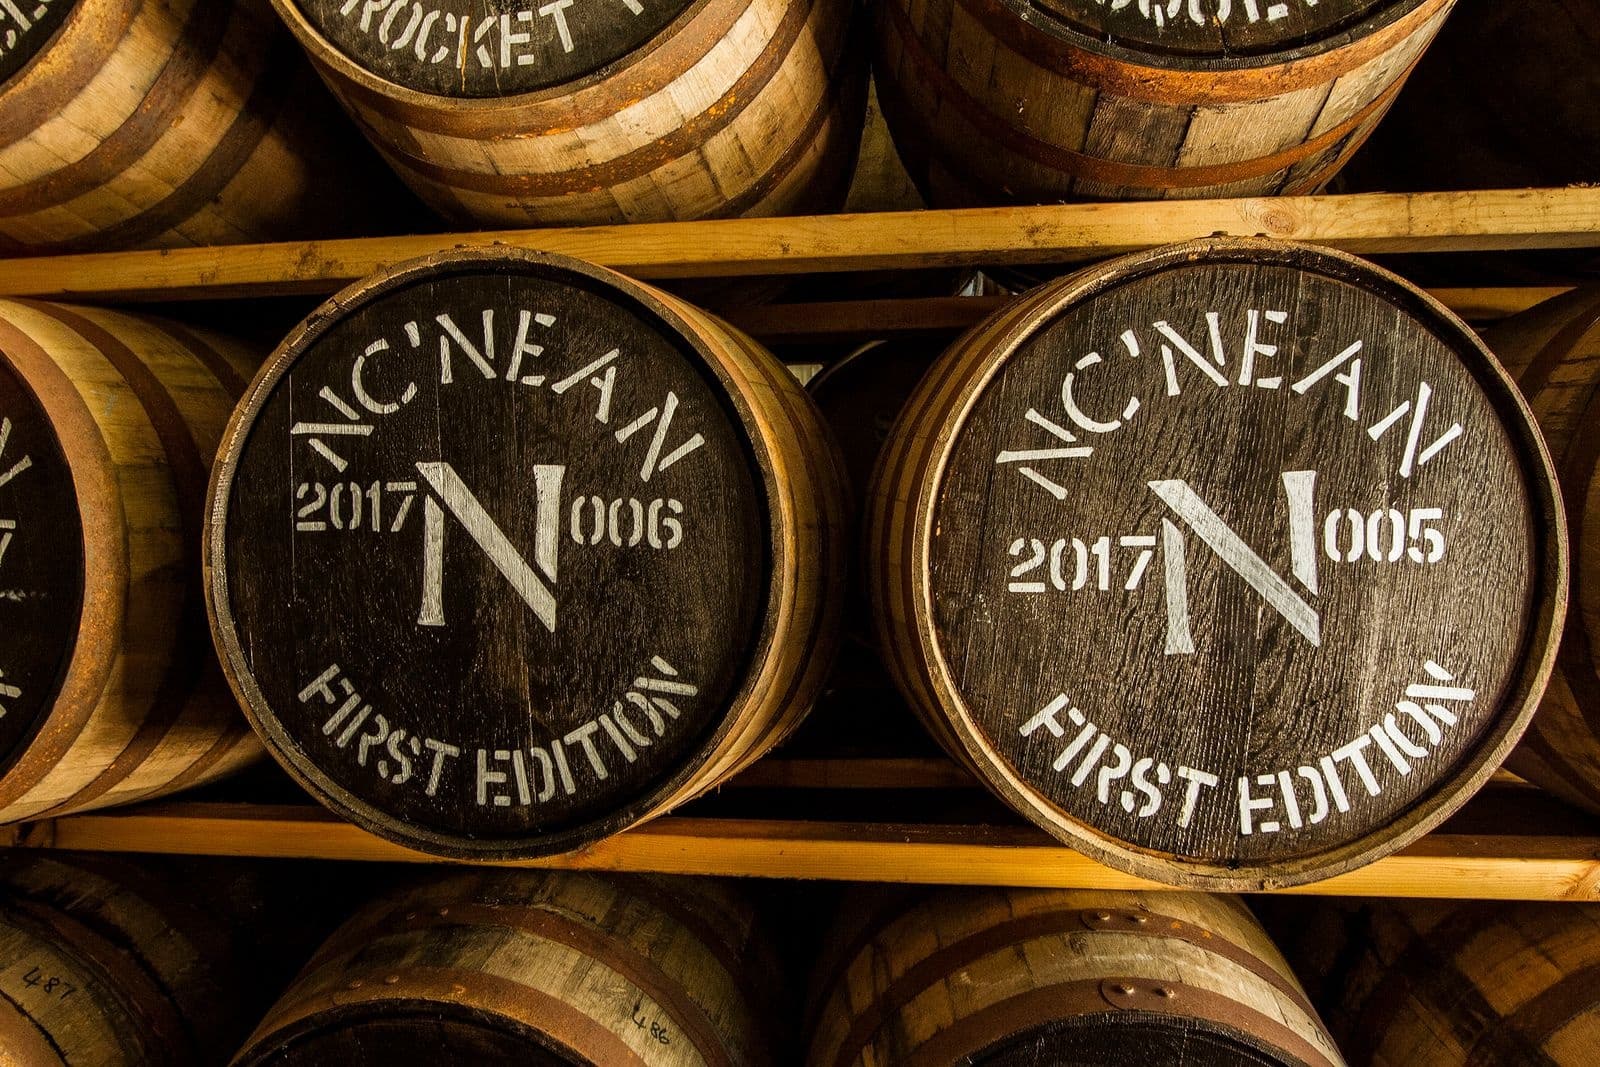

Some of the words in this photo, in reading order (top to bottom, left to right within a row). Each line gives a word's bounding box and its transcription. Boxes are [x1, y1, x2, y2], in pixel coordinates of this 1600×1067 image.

[291, 309, 705, 482] NC'NEAN
[996, 309, 1463, 500] NC'NEAN
[296, 480, 417, 532] 2017
[415, 462, 566, 632] N
[571, 495, 684, 549] 006
[1008, 536, 1156, 593] 2017
[1147, 470, 1320, 655] N
[1324, 507, 1445, 564] 005
[298, 664, 460, 796] FIRST
[477, 655, 698, 807] EDITION
[1019, 692, 1217, 828] FIRST
[1238, 660, 1476, 835] EDITION
[23, 967, 77, 1000] 487
[632, 1001, 671, 1045] 486
